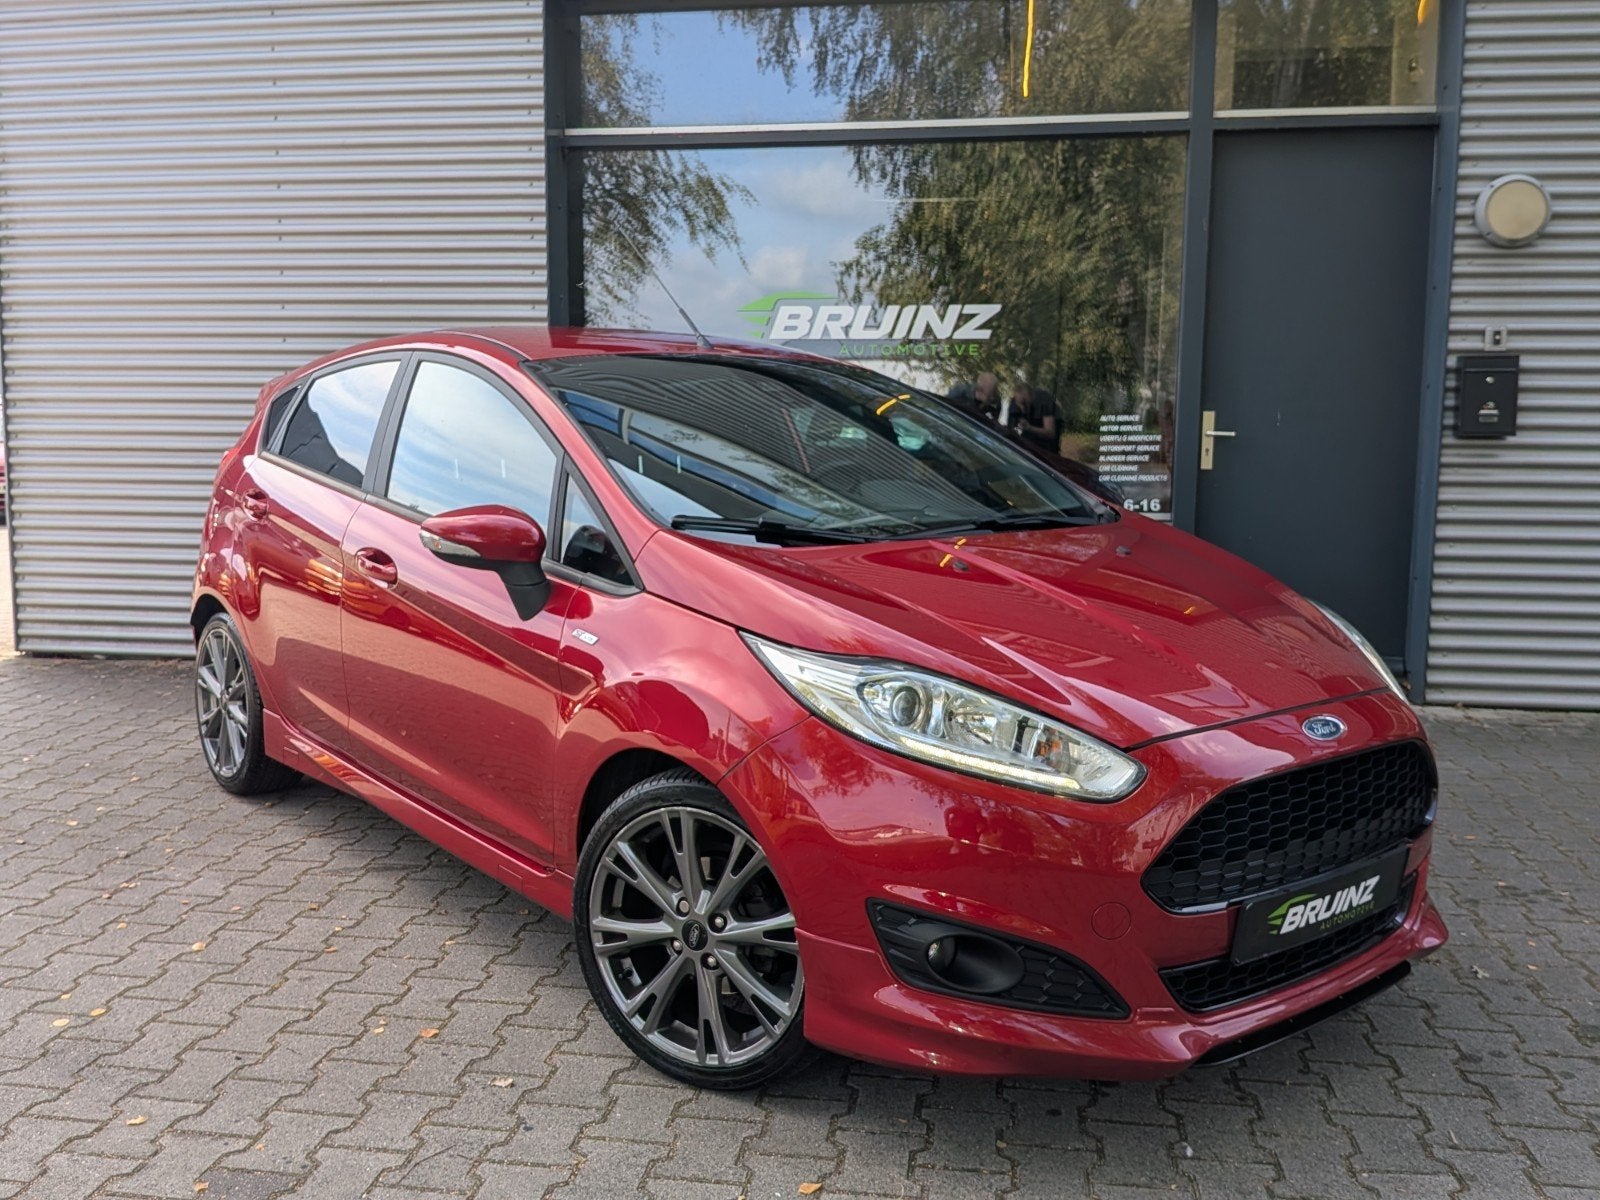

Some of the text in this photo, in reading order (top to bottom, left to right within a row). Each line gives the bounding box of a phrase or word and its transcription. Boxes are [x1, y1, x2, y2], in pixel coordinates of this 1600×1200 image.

[769, 304, 1002, 340] BRUINZ
[839, 343, 981, 356] AUTOMOTIVE
[1280, 875, 1380, 935] BRUINZ
[1320, 901, 1375, 930] AUTOMOTIVE
